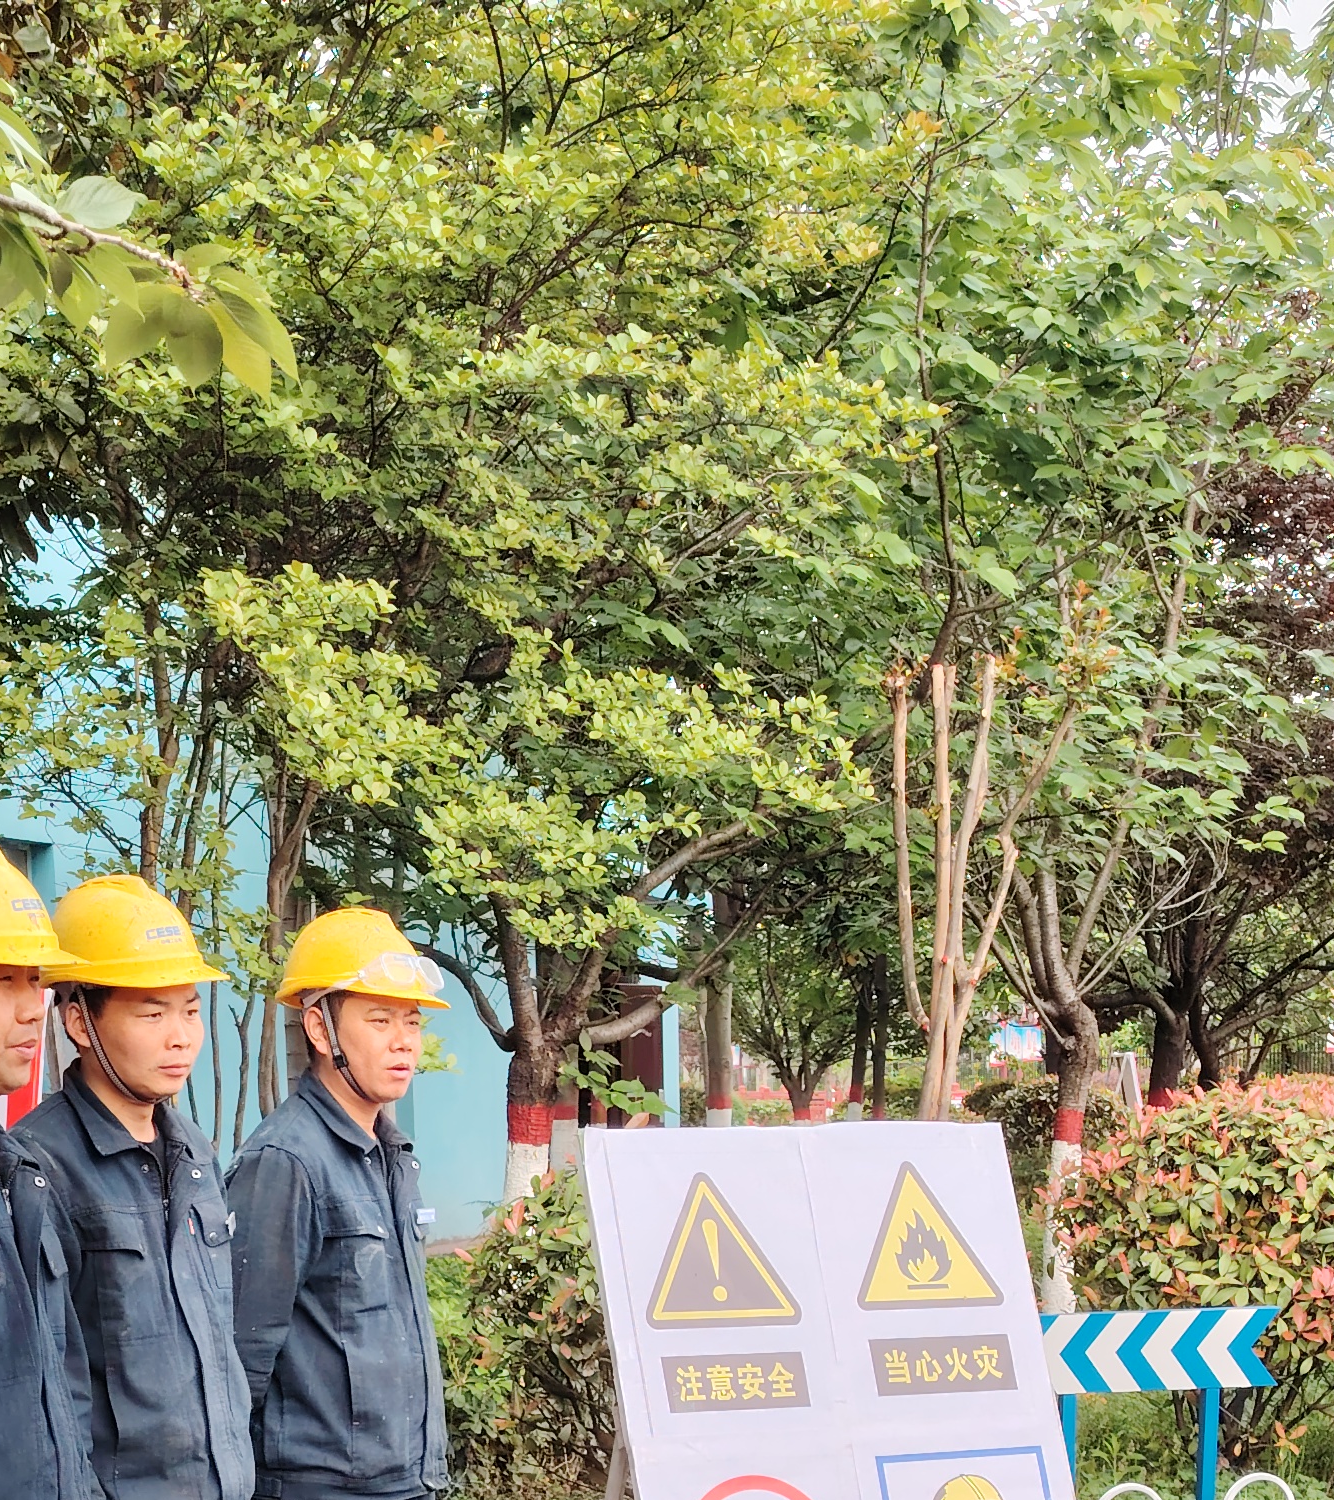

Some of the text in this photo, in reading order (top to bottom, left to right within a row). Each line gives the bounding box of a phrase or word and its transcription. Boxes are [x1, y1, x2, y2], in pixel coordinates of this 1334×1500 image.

[676, 1362, 797, 1402] 注意安全
[884, 1345, 1004, 1384] 当心火灾
